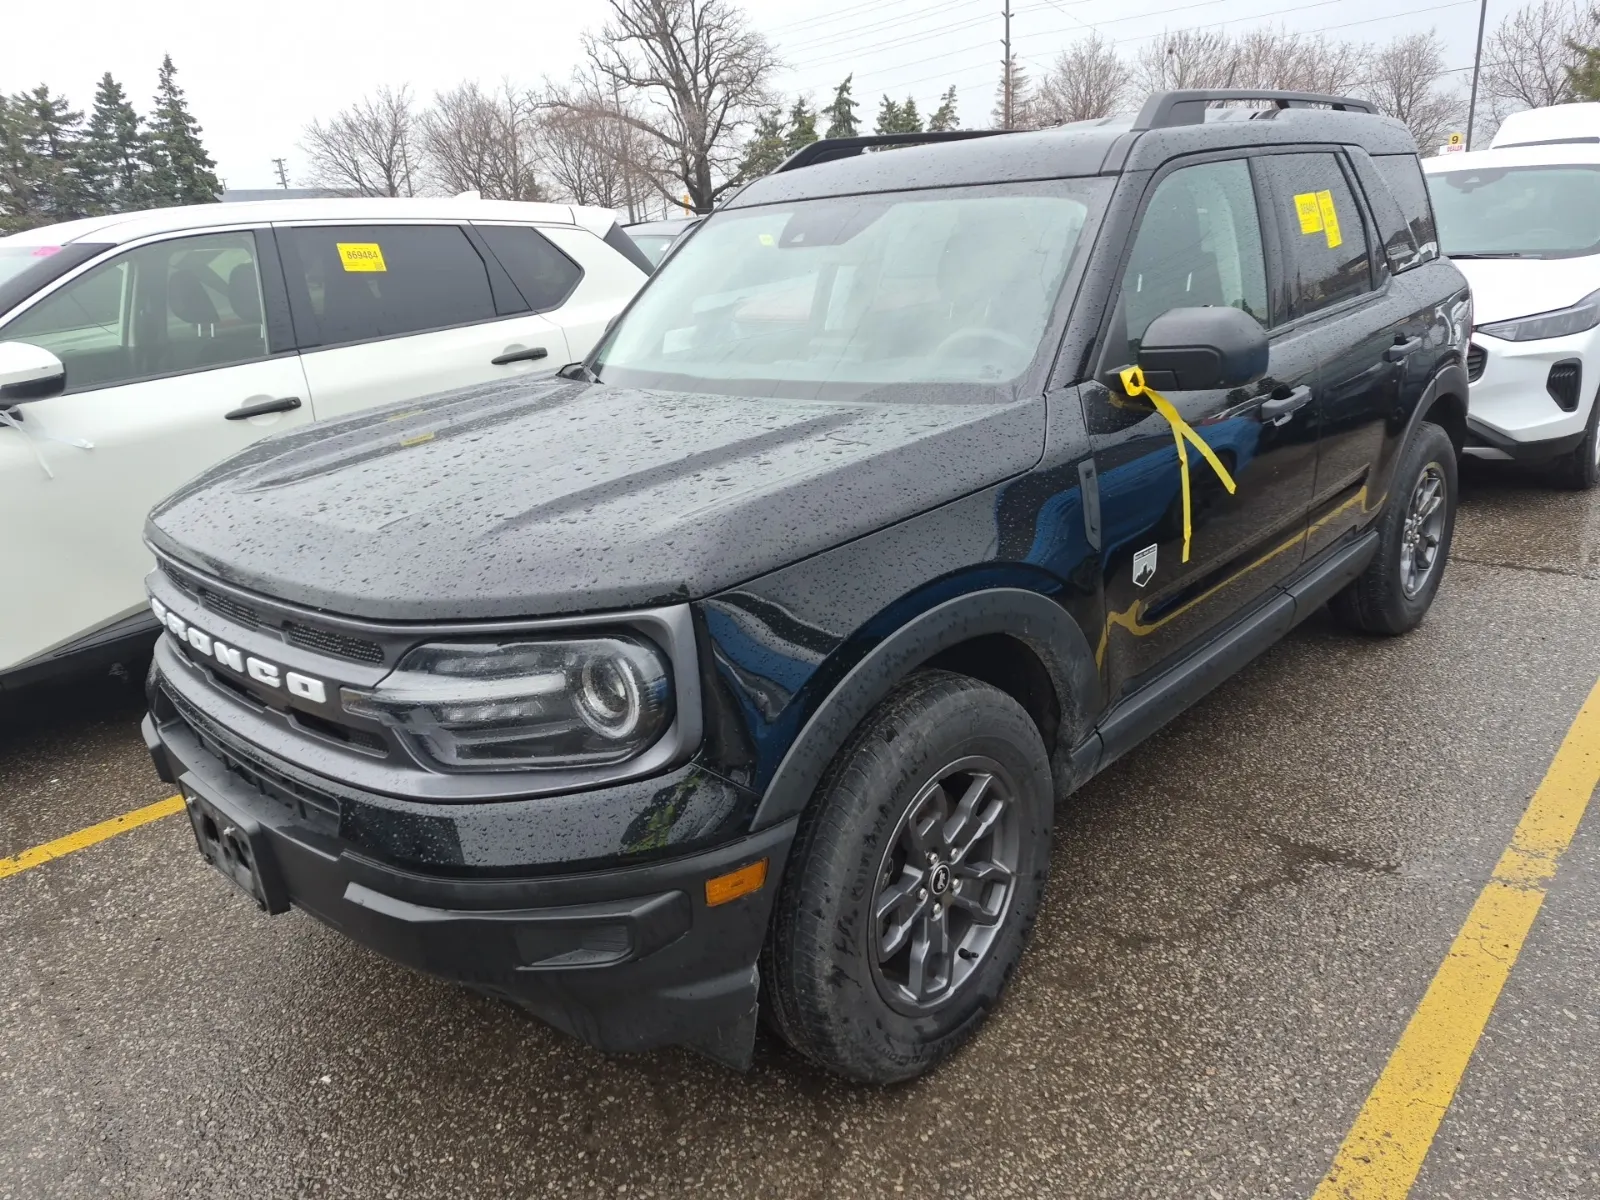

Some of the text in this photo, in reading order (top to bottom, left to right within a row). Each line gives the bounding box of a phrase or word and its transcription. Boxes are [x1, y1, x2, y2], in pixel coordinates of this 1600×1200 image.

[1451, 135, 1459, 145] 9
[1446, 144, 1463, 152] DEALER
[346, 250, 379, 260] 869484
[151, 597, 327, 704] BRONCO
